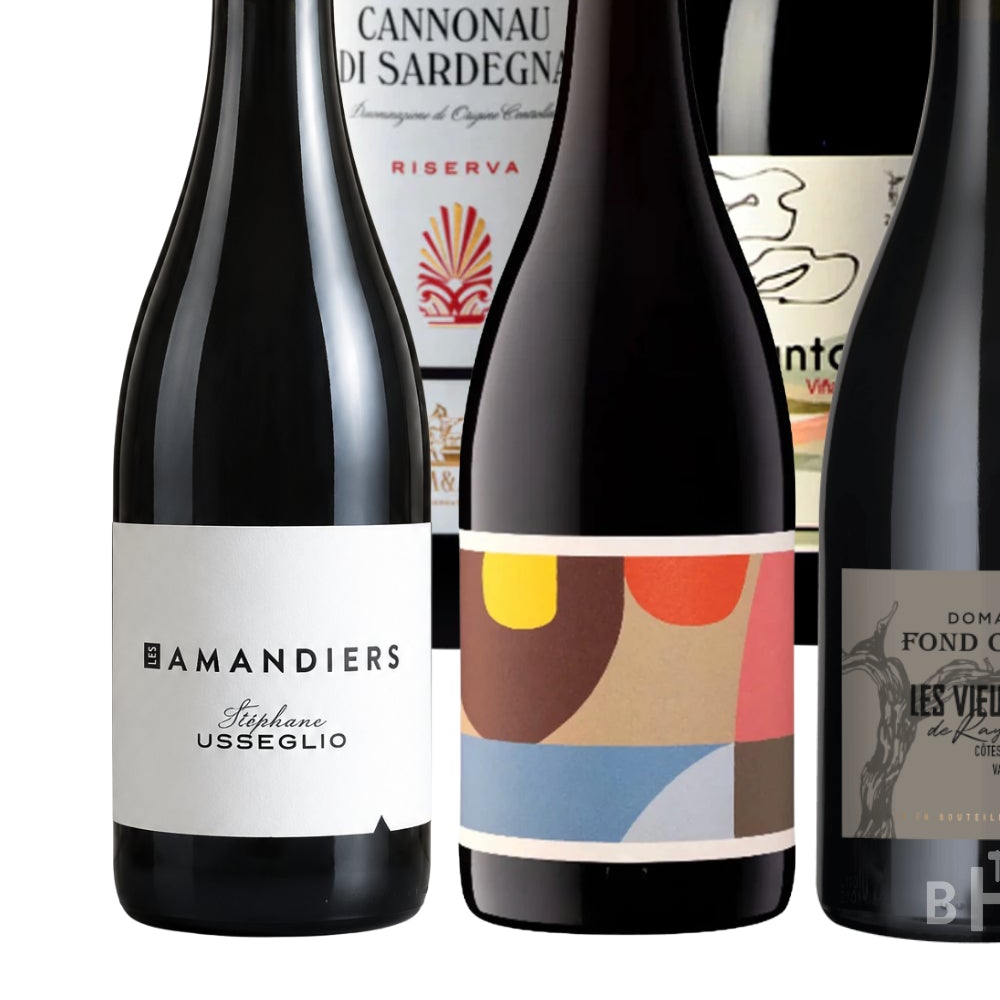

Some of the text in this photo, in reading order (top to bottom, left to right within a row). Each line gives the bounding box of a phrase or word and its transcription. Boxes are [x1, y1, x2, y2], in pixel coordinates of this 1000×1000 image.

[358, 5, 550, 42] CANNONAU
[340, 50, 365, 84] DI
[392, 161, 519, 175] RISERVA
[901, 632, 978, 651] FOND
[148, 644, 399, 673] LES AMANDIERS
[910, 684, 945, 717] LES
[217, 698, 327, 735] Stéphane
[927, 719, 952, 738] de
[197, 732, 347, 750] USSEGLIO
